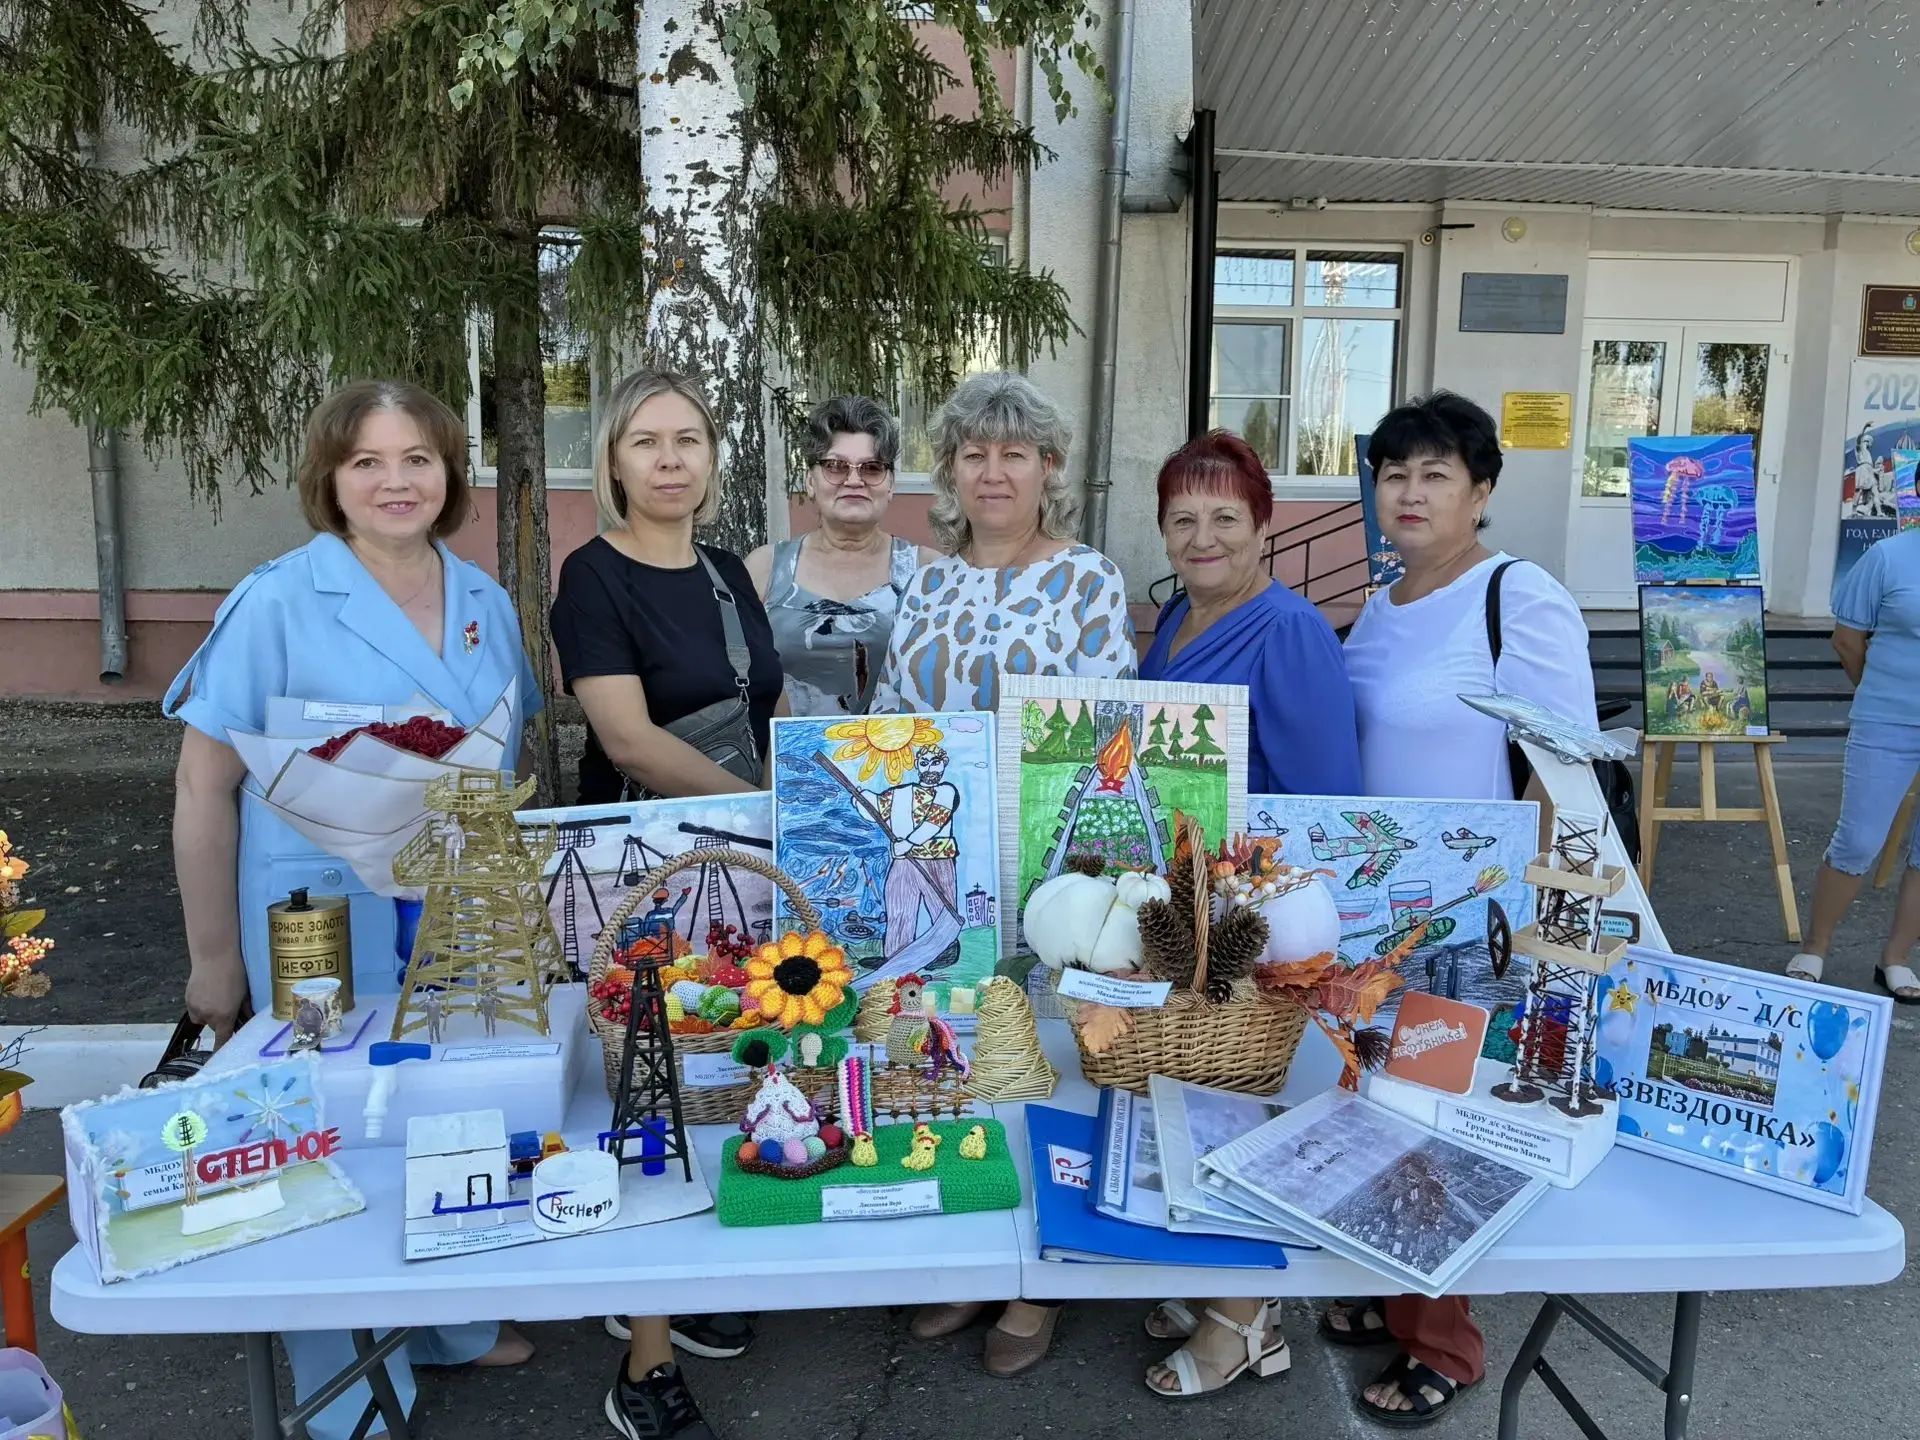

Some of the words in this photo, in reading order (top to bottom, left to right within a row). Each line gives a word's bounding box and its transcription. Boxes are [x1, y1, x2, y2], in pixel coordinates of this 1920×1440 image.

[1863, 374, 1920, 411] 202
[1845, 528, 1868, 540] ГОД
[278, 936, 300, 944] ЖИВАЯ
[304, 932, 337, 943] ЛЕГЕНДА
[282, 958, 334, 974] НЕФТЬ
[1644, 978, 1732, 1010] МБДОУ
[1754, 1002, 1803, 1029] Д/С
[1415, 1019, 1446, 1037] днем
[1455, 1108, 1488, 1124] МБДОУ
[1604, 1077, 1816, 1148] «ЗВЕЗДОЧКА»
[1465, 1121, 1494, 1136] Группа
[1496, 1131, 1538, 1148] «Росинка»
[1452, 1127, 1474, 1139] семья
[1520, 1148, 1551, 1163] Матвея
[197, 1126, 343, 1184] СТЕПНОЕ
[144, 1162, 182, 1176] МБДОУ
[143, 1186, 170, 1197] семья
